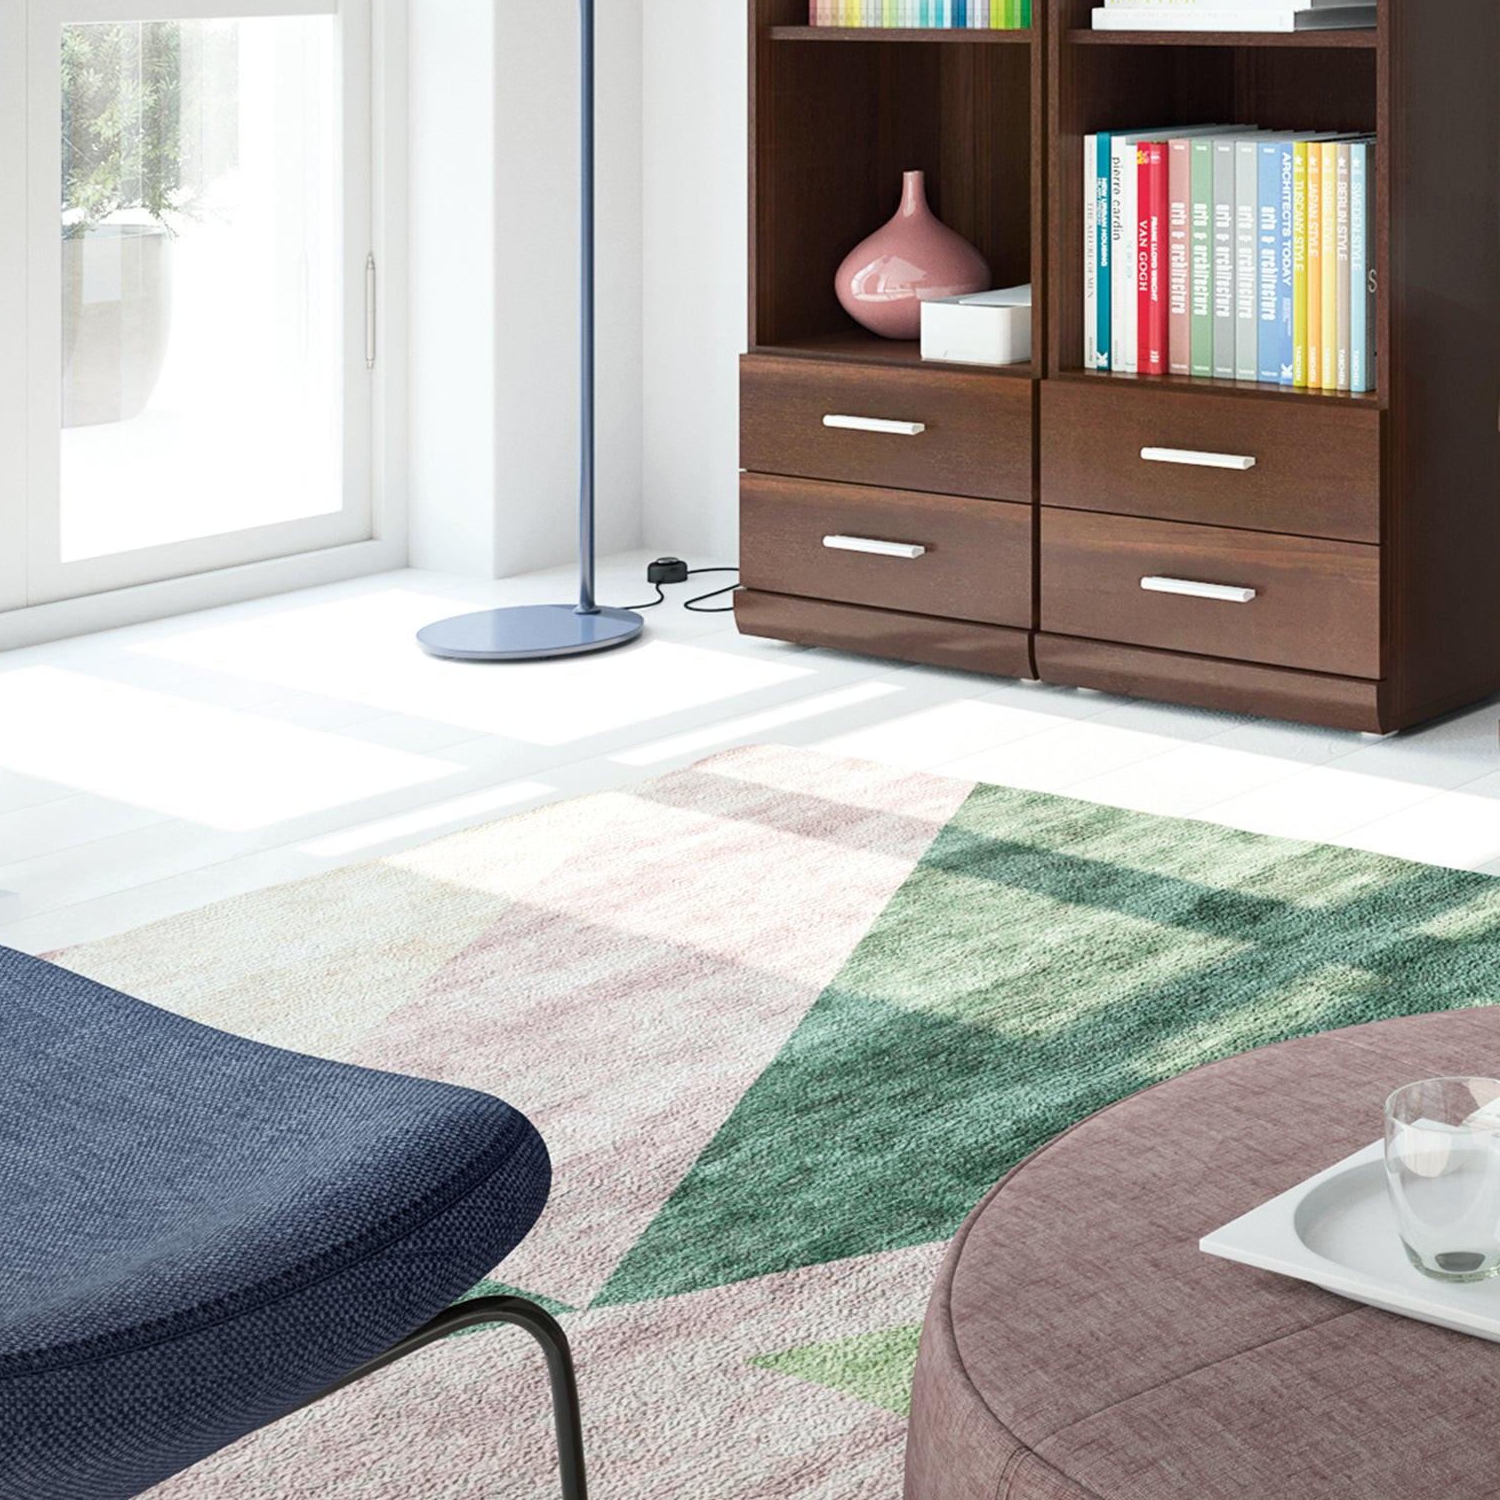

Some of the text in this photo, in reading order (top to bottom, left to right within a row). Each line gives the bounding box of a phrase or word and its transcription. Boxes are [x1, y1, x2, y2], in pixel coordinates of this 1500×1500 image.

[1112, 156, 1123, 196] pierre
[1282, 151, 1292, 237] ARCHITECTS
[1113, 198, 1124, 242] cardin
[1171, 202, 1185, 225] arts
[1193, 203, 1207, 226] arts
[1215, 204, 1230, 227] arts
[1238, 205, 1253, 228] arts
[1261, 206, 1275, 230] arts
[1294, 180, 1304, 272] TUSCANY STYLE
[1308, 180, 1318, 257] JAPAN STYLE
[1337, 181, 1347, 260] BERLIN STYLE
[1352, 181, 1362, 271] SWEDEN STYLE
[1139, 220, 1148, 291] VAN GOGH
[1171, 243, 1187, 314] architecture
[1193, 245, 1209, 316] architecture
[1215, 246, 1232, 317] architecture
[1238, 247, 1255, 318] architecture
[1261, 248, 1277, 320] architecture
[1282, 239, 1292, 286] TODAY
